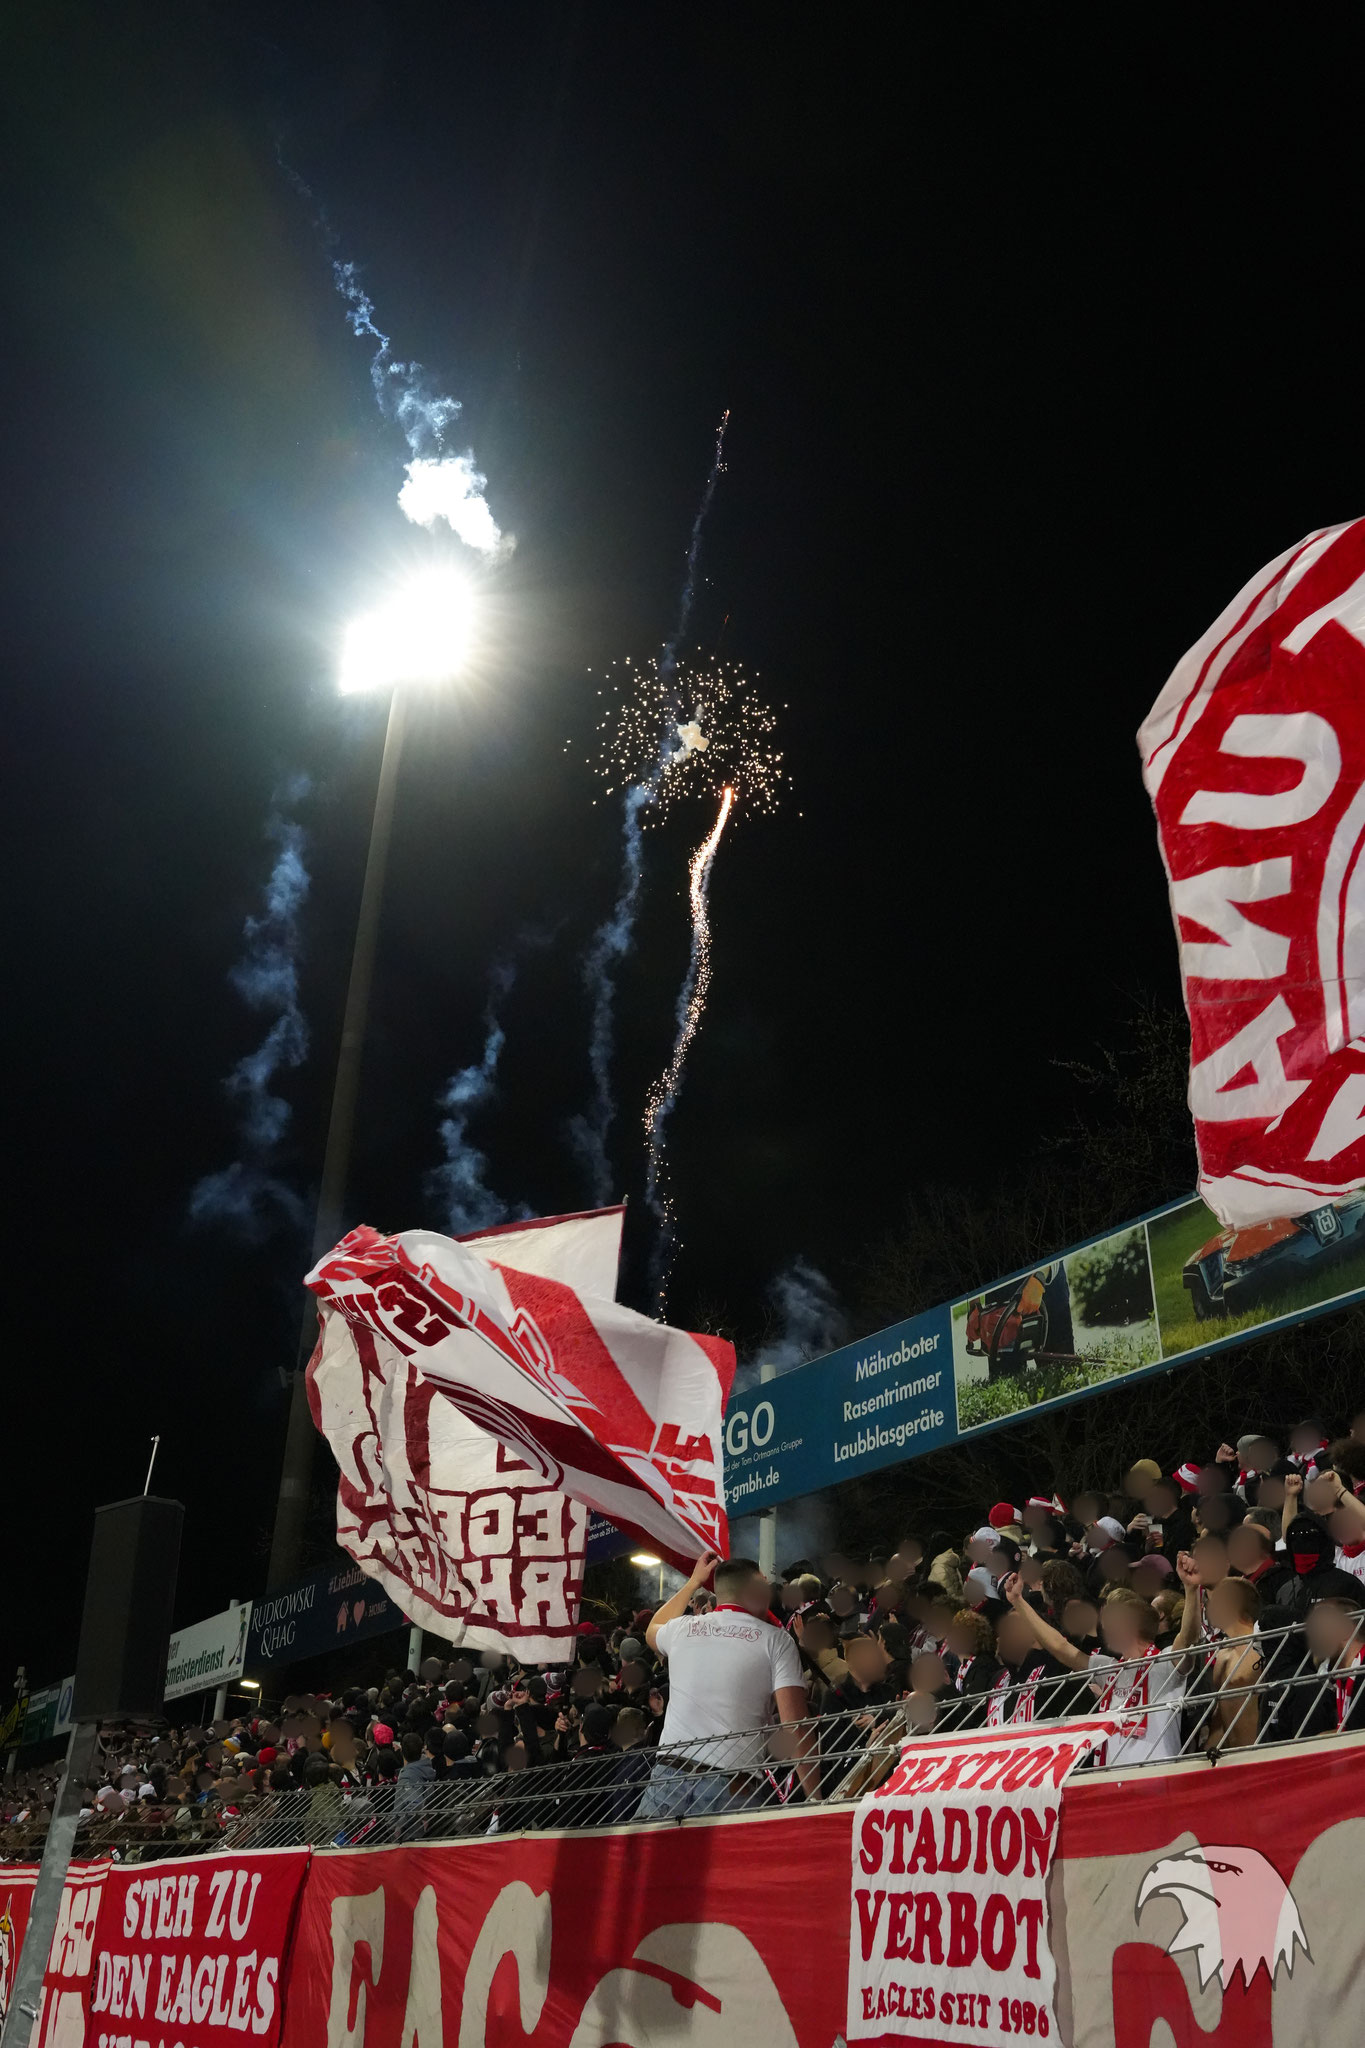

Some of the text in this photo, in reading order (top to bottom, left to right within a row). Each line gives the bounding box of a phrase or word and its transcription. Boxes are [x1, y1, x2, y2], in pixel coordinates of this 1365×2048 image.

[855, 1332, 941, 1383] Mähroboter
[842, 1369, 942, 1422] Rasentrimmer
[731, 1460, 740, 1470] der
[741, 1456, 752, 1466] Tom
[753, 1447, 780, 1462] Ortmanns
[780, 1438, 803, 1452] Gruppe
[833, 1408, 946, 1464] Laubblasgeräte
[252, 1584, 316, 1633] RUDKOWSKI
[368, 1600, 388, 1617] HOME
[260, 1620, 297, 1658] &HAG
[874, 1739, 1092, 1798] SEKTION
[858, 1805, 1058, 1878] STADION
[124, 1869, 263, 1942] STEH ZU
[854, 1888, 1044, 1980] VERBOT
[91, 1950, 153, 2021] DEN
[155, 1949, 281, 2036] EAGLES
[860, 1982, 1051, 2038] EAGLES SEIT 1986
